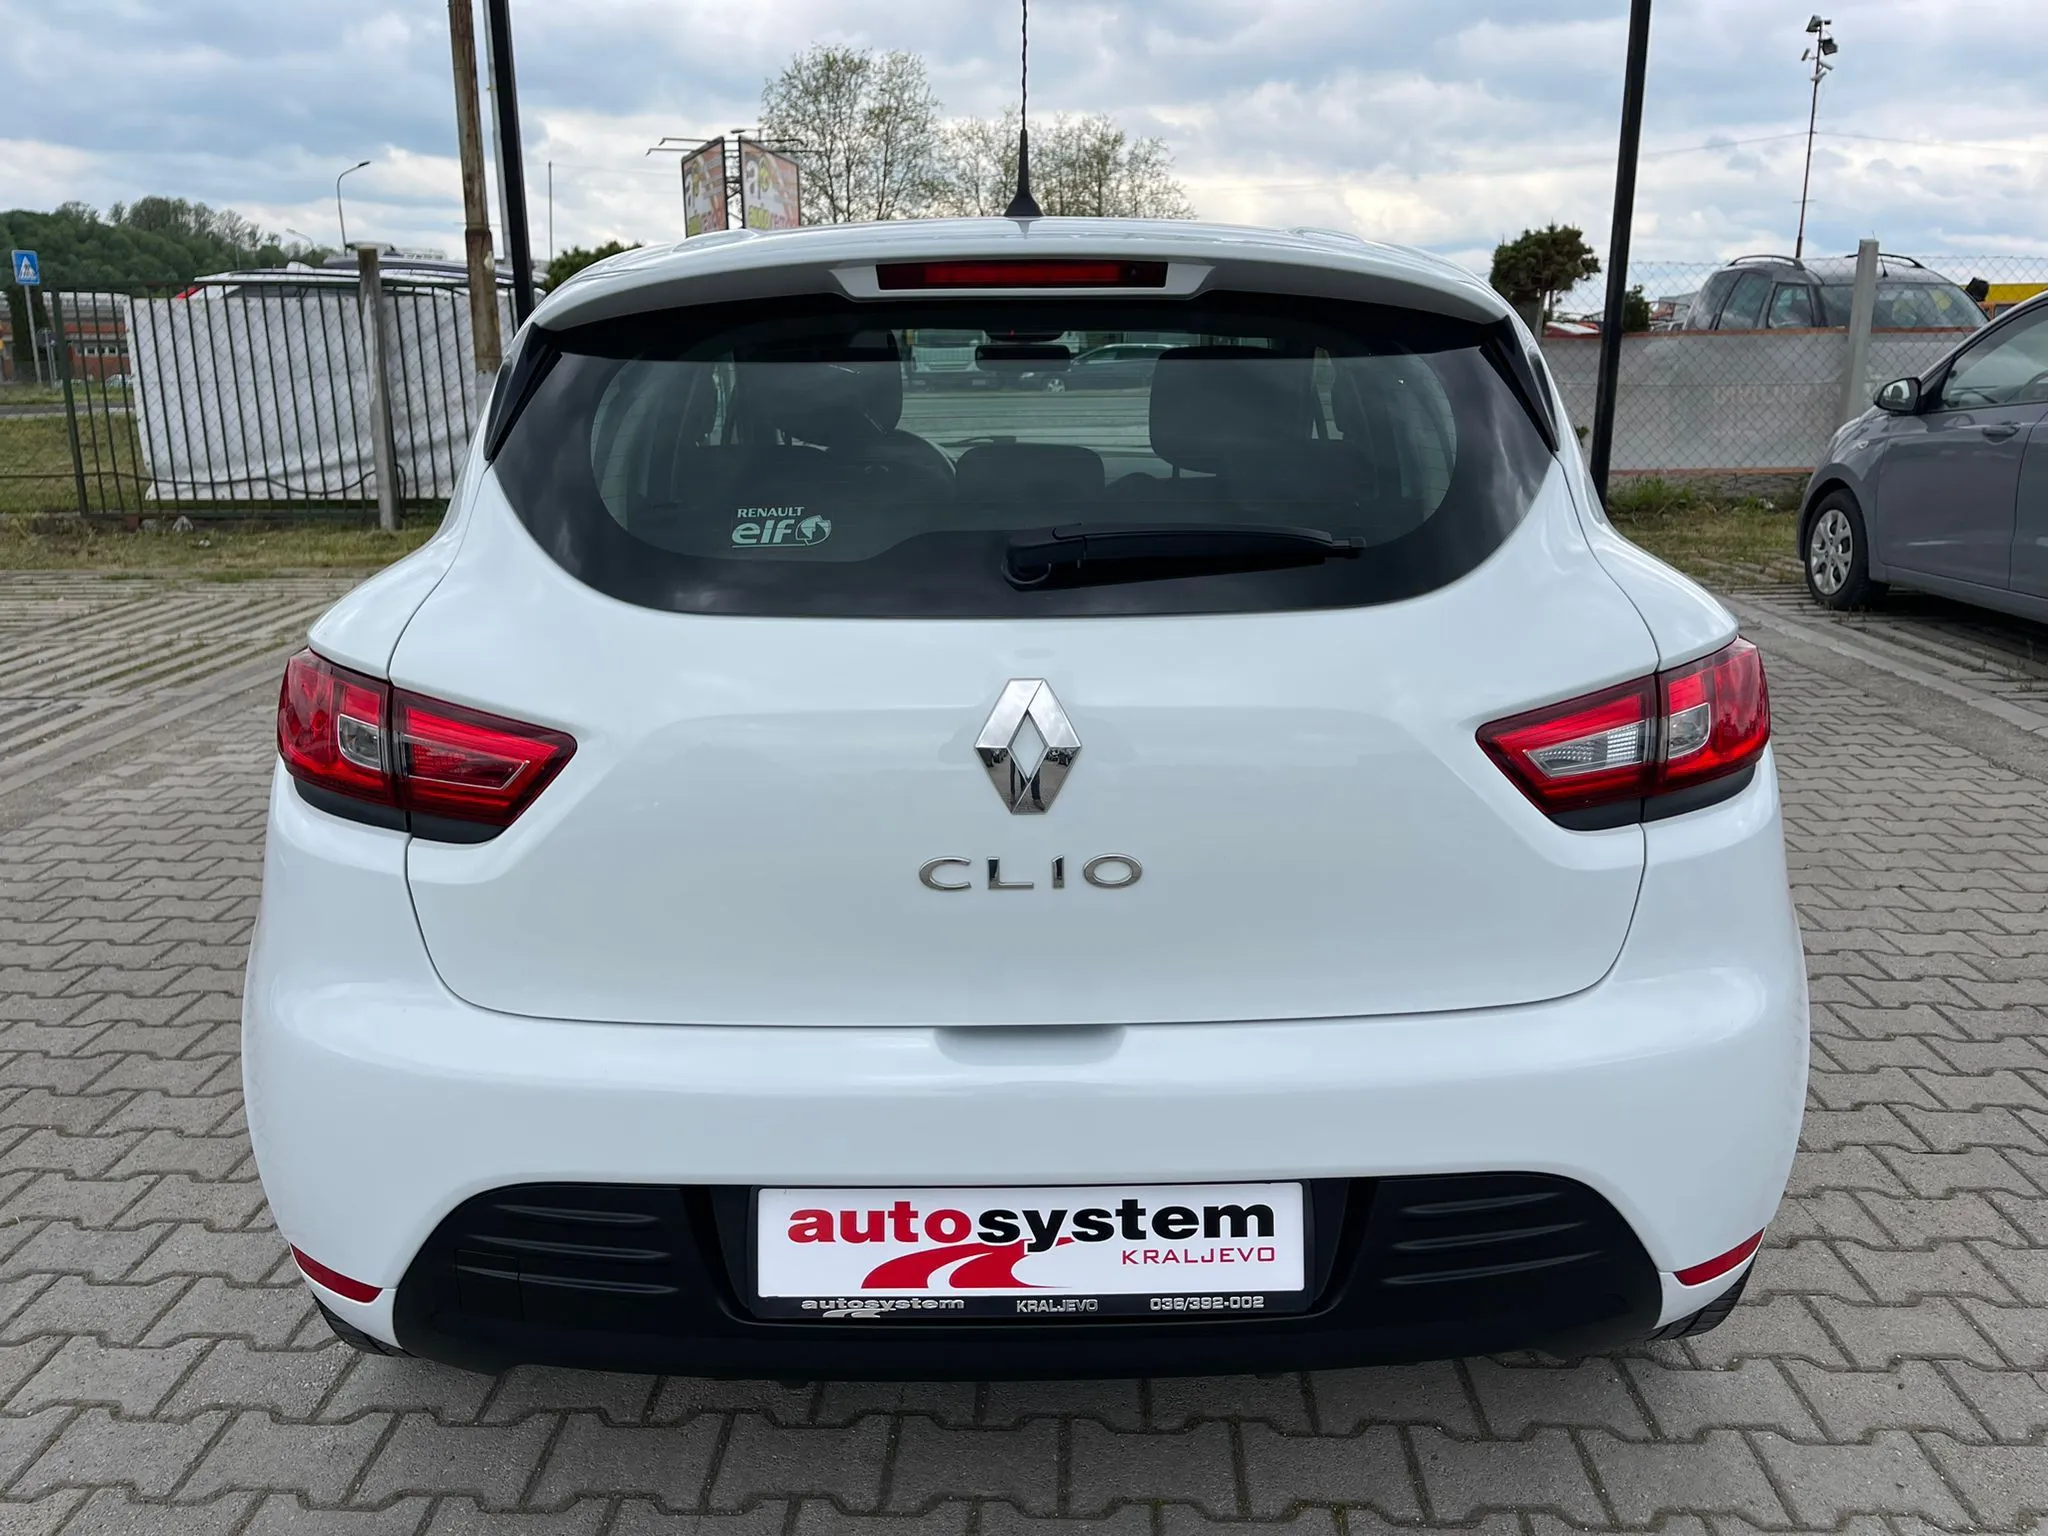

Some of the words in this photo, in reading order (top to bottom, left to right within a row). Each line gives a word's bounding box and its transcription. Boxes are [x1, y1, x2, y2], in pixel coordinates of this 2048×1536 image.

[737, 506, 805, 518] RENAULT
[732, 519, 795, 544] elf
[919, 853, 1143, 891] CLIO
[787, 1198, 1275, 1253] autosystem
[1122, 1246, 1275, 1265] KRALJEVO
[801, 1298, 965, 1312] autosystem
[1016, 1299, 1099, 1313] KRALJEVO
[1150, 1295, 1265, 1312] 036/392-002
